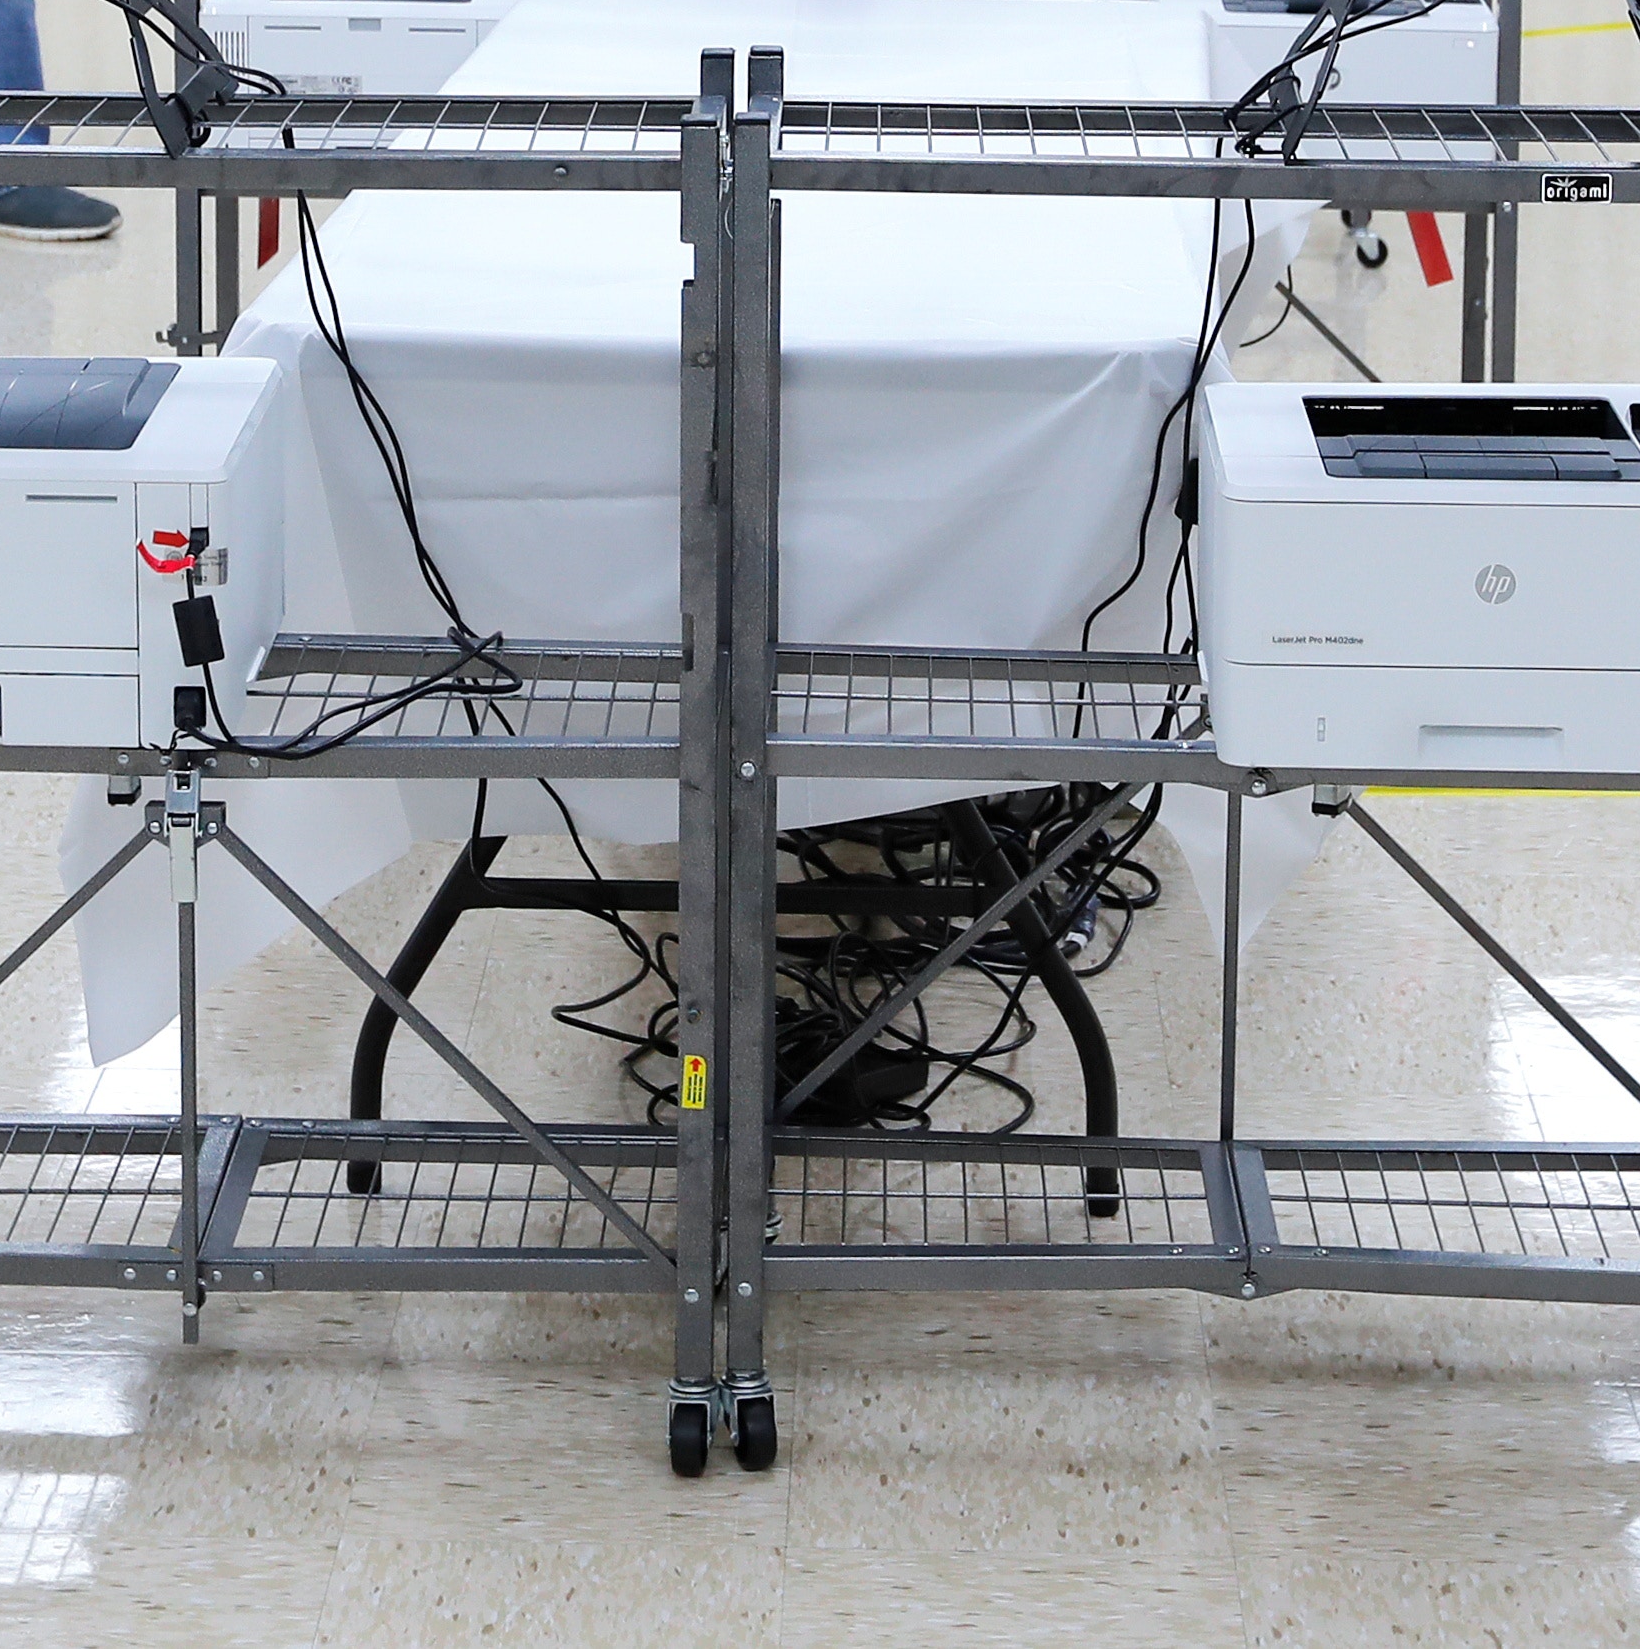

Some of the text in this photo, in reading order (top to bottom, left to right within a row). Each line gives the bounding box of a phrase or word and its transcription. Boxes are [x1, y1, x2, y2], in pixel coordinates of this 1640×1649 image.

[1476, 563, 1516, 604] hp
[1272, 636, 1364, 645] LaserJet Pro M402dne
